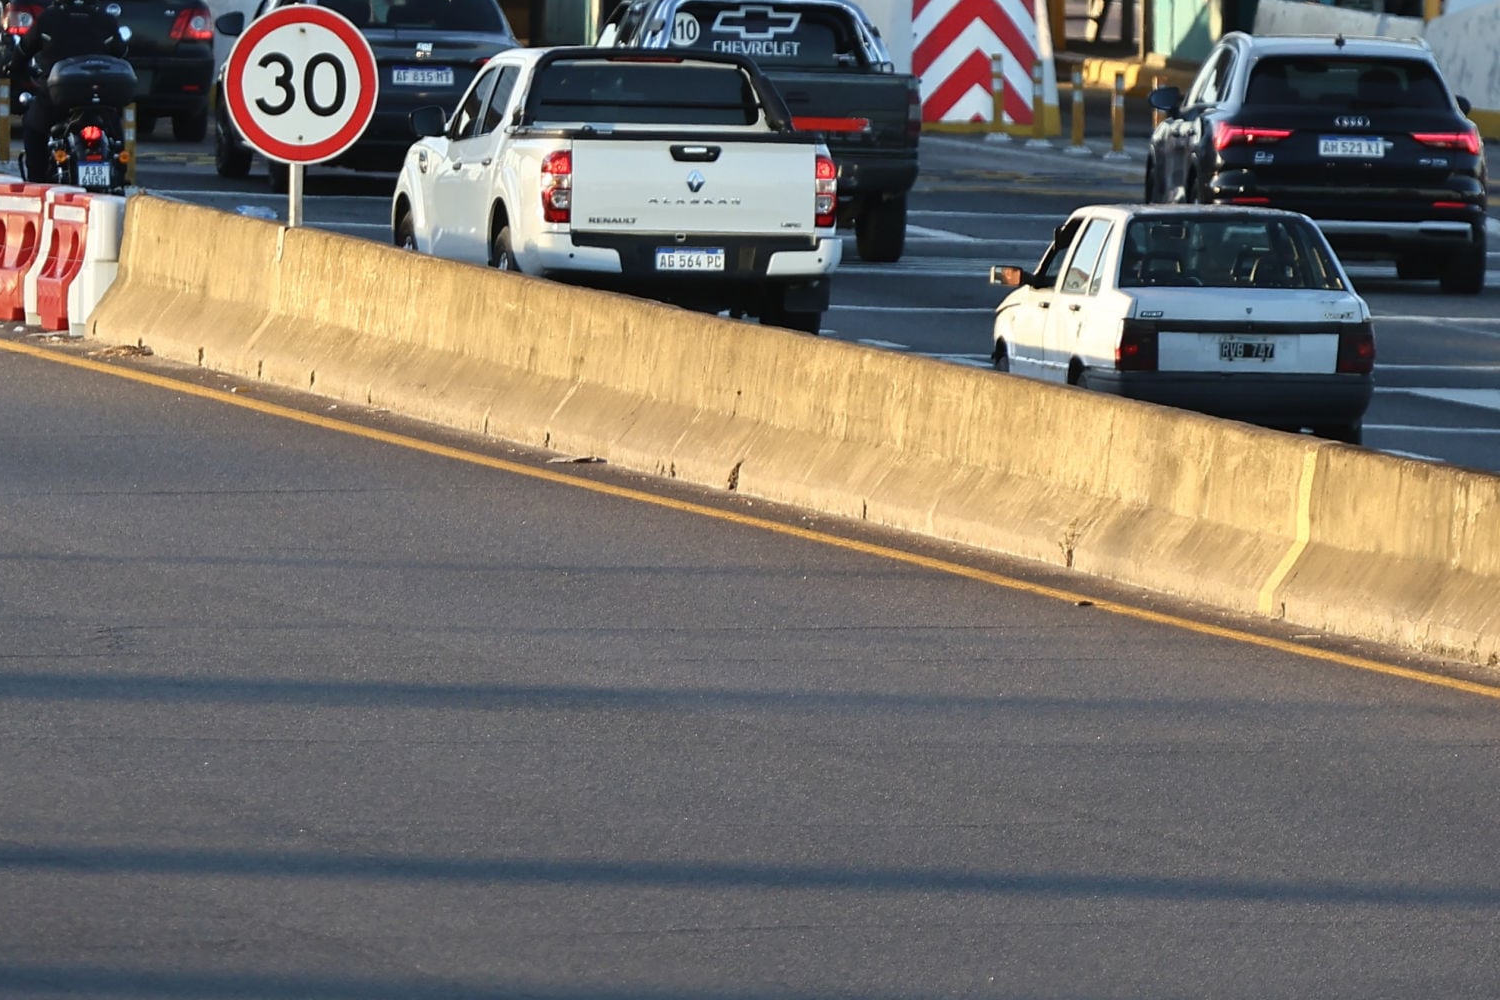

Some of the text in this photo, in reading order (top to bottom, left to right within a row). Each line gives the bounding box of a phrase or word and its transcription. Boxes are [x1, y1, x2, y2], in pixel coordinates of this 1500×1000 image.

[396, 71, 409, 81] AF
[255, 52, 347, 118] 30
[1323, 141, 1338, 153] AH
[1341, 141, 1363, 153] 521
[588, 216, 637, 224] RENAULT
[659, 255, 722, 268] AG 564 PC
[1251, 343, 1273, 357] 747
